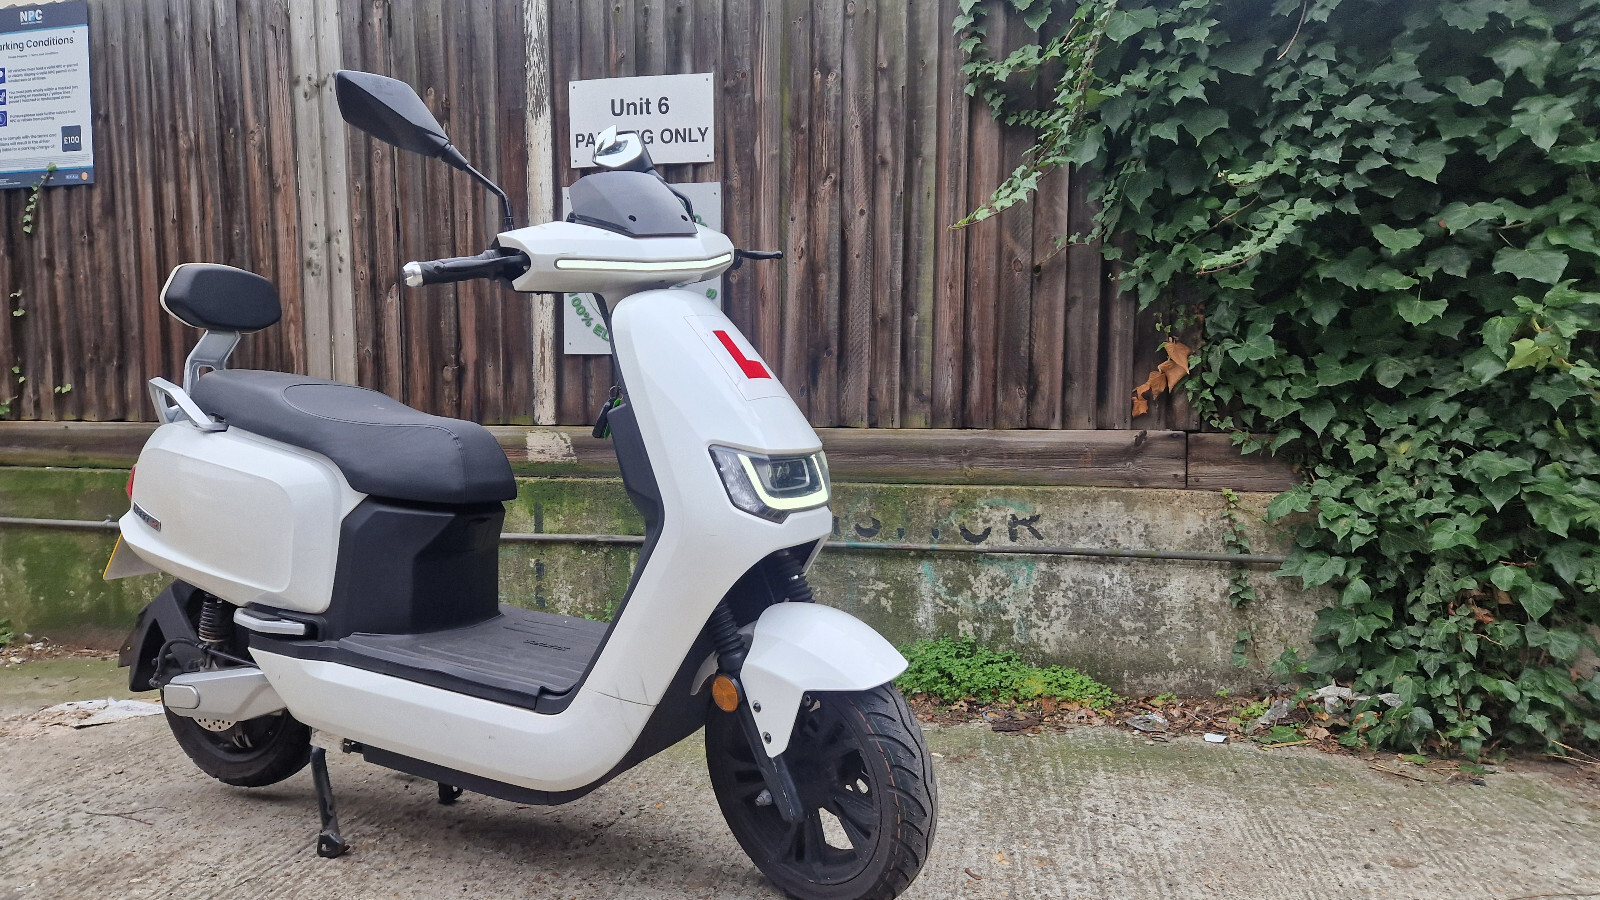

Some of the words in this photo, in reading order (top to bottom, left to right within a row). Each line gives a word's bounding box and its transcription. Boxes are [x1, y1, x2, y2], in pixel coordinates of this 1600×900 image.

[20, 9, 43, 22] NPC
[26, 36, 74, 48] Conditions
[610, 97, 651, 117] Unit
[657, 96, 670, 115] 6
[63, 136, 80, 145] £100
[660, 126, 709, 144] ONLY
[712, 330, 772, 379] L
